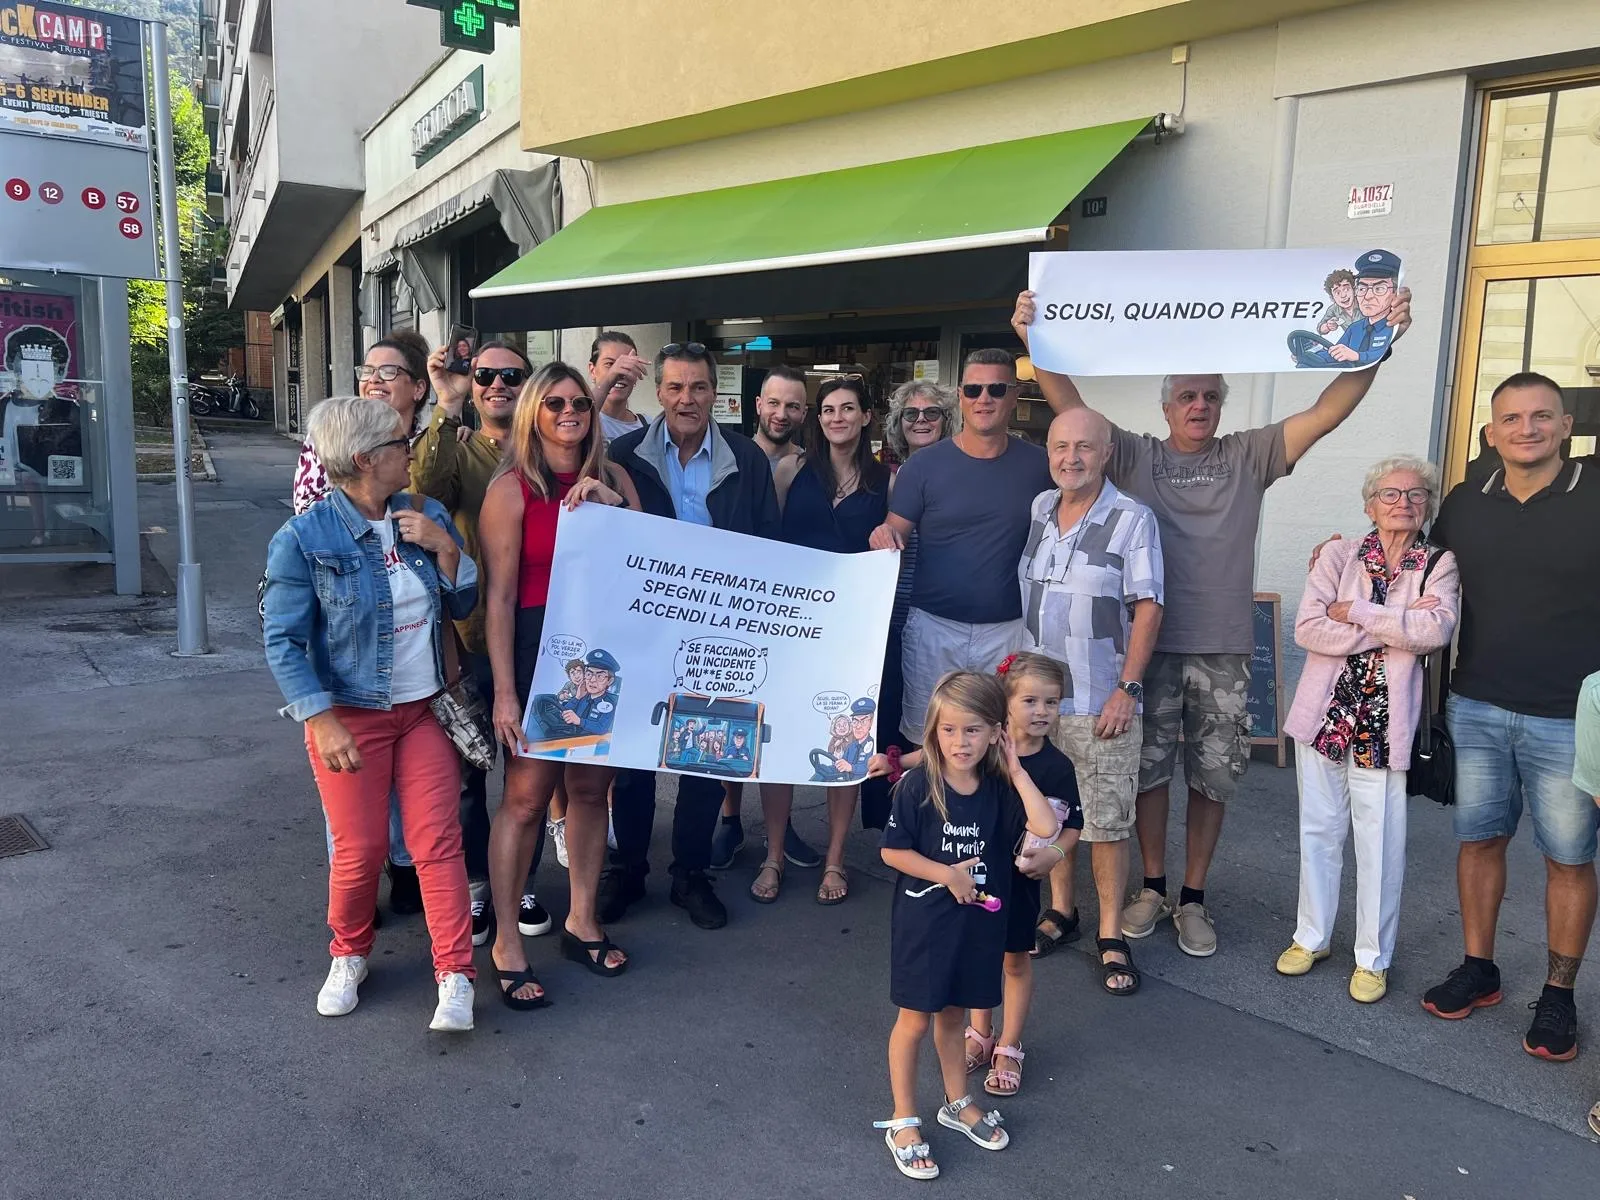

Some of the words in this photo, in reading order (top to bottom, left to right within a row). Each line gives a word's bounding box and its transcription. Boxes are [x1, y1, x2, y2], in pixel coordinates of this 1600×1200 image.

[0, 4, 37, 40] CK
[11, 37, 50, 49] FESTIVAL
[59, 44, 92, 57] TRIESTE
[31, 85, 110, 112] SEPTEMBER
[31, 101, 71, 115] PROSECCO
[80, 108, 109, 120] TRIESTE
[13, 184, 23, 196] 9
[43, 187, 58, 199] 12
[88, 192, 99, 204] B
[117, 195, 137, 210] 57
[123, 223, 140, 234] 58
[1043, 303, 1115, 323] SCUSI,
[1124, 302, 1225, 321] QUANDO
[1230, 301, 1324, 319] PARTE?
[626, 554, 687, 579] ULTIMA
[690, 567, 767, 594] FERMATA
[771, 583, 835, 603] ENRICO
[643, 579, 707, 604] SPEGNI
[709, 591, 723, 607] IL
[727, 595, 812, 620] MOTORE...
[394, 618, 428, 634] APPINESS
[628, 598, 707, 624] ACCENDI
[709, 613, 730, 629] LA
[735, 617, 823, 639] PENSIONE
[687, 642, 702, 653] SE
[703, 644, 756, 658] FACCIAMO
[685, 655, 700, 666] UN
[703, 656, 757, 670] INCIDENTE
[724, 671, 754, 681] SOLO
[692, 680, 702, 690] IL
[705, 681, 746, 693] COND...
[943, 822, 980, 837] Quando
[941, 837, 953, 853] la
[956, 840, 985, 859] parti?
